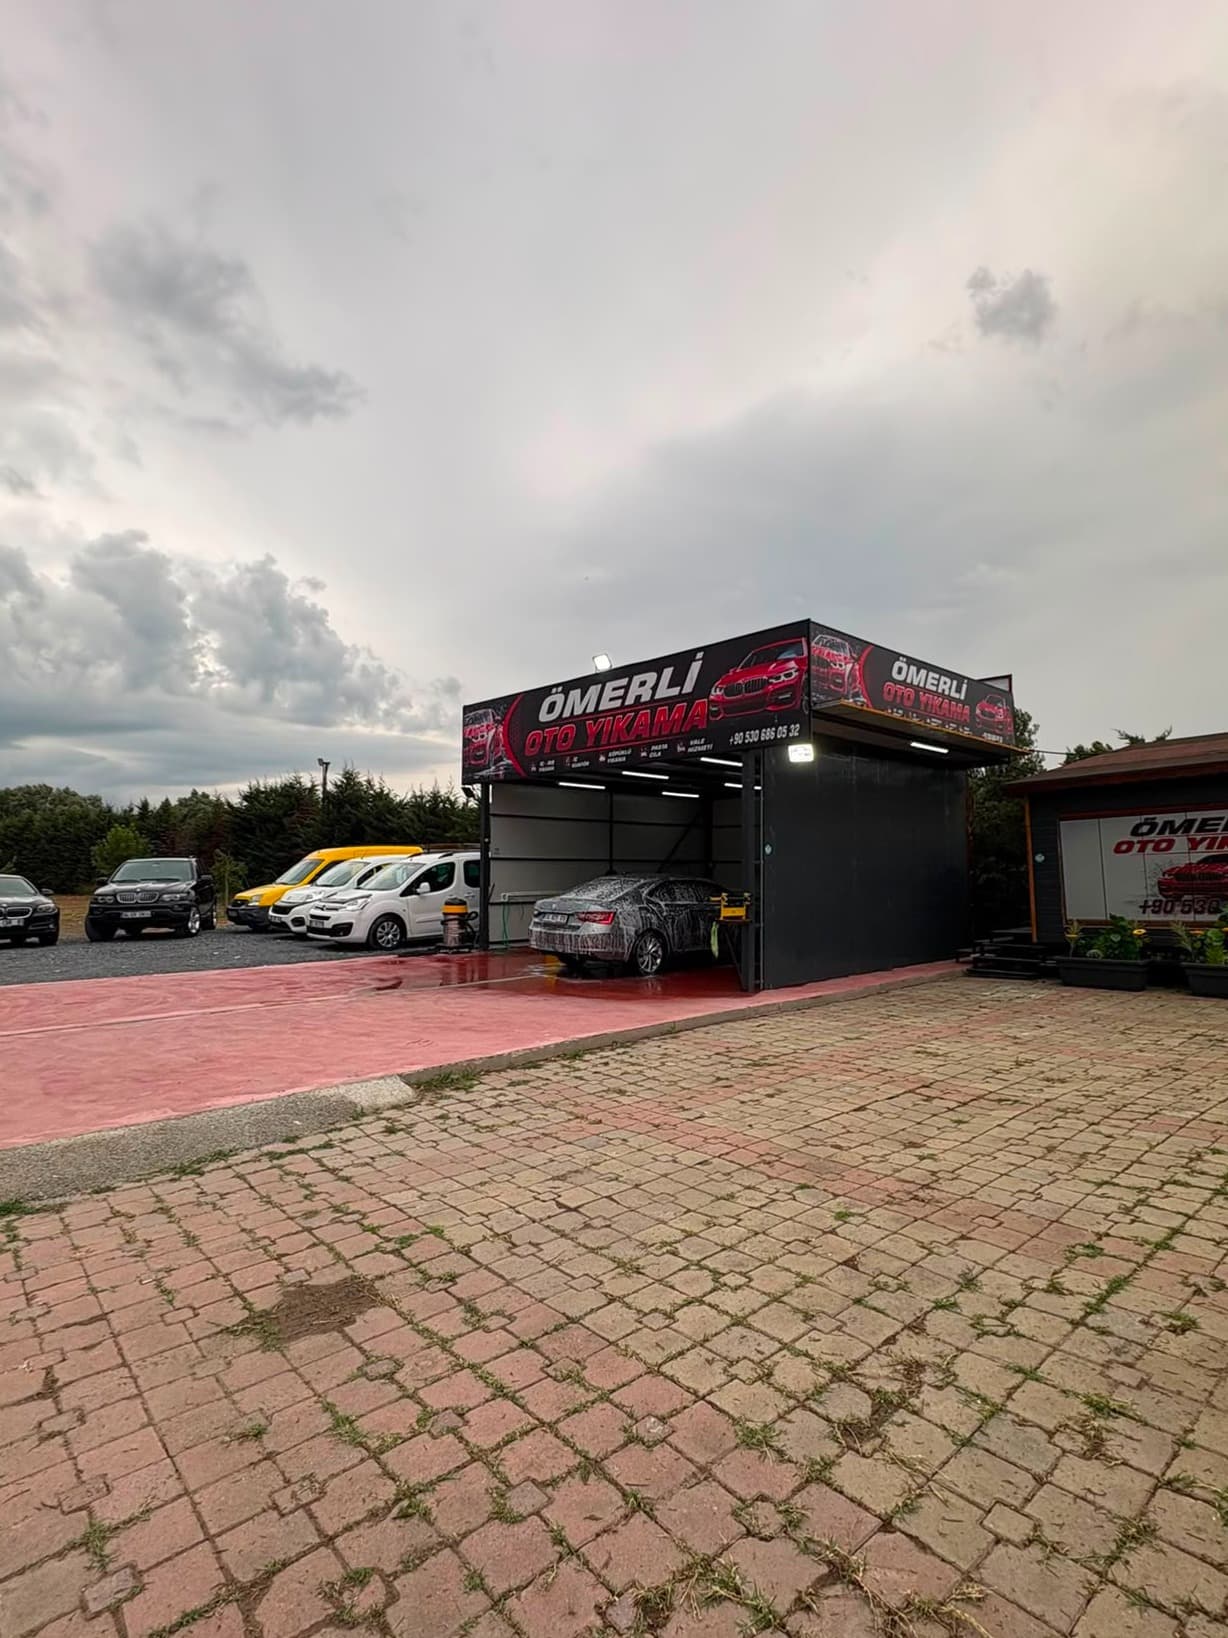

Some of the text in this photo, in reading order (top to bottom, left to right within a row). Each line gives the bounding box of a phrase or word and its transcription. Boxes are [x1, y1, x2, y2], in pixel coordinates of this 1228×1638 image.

[538, 651, 703, 722] ÖMERLİ
[892, 656, 967, 700] ÖMERLİ
[883, 682, 970, 722] OTO YIKAMA
[524, 698, 707, 756] OTO YIKAMA
[745, 730, 760, 743] 530
[777, 725, 788, 739] 05
[789, 723, 800, 737] 32
[1113, 838, 1175, 854] OTO
[1139, 899, 1174, 915] +90
